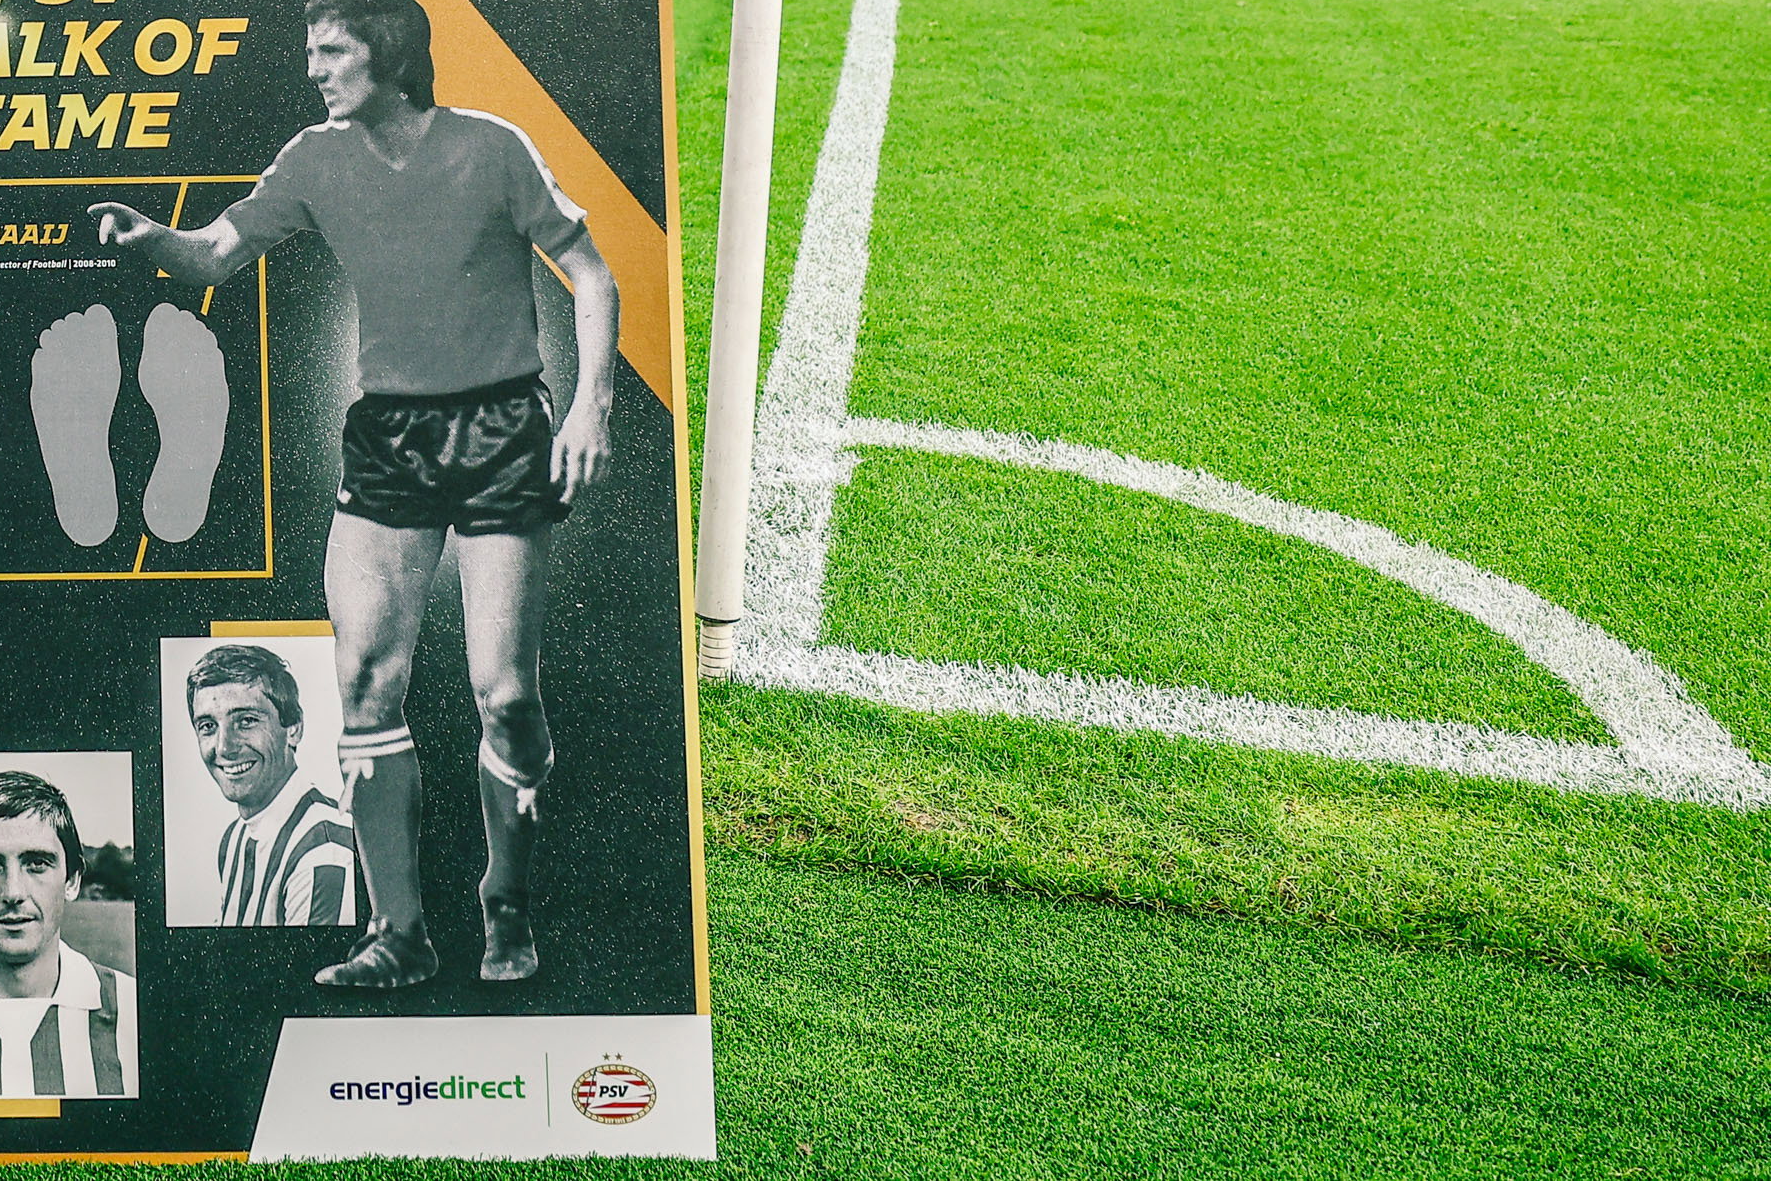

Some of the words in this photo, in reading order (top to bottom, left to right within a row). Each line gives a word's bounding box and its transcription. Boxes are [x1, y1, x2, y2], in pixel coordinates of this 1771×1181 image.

[134, 18, 249, 76] OF
[23, 259, 31, 270] of
[32, 259, 67, 269] Football
[72, 259, 116, 268] 2008-2010
[329, 1075, 526, 1106] energiedirect
[598, 1084, 628, 1098] PSV
